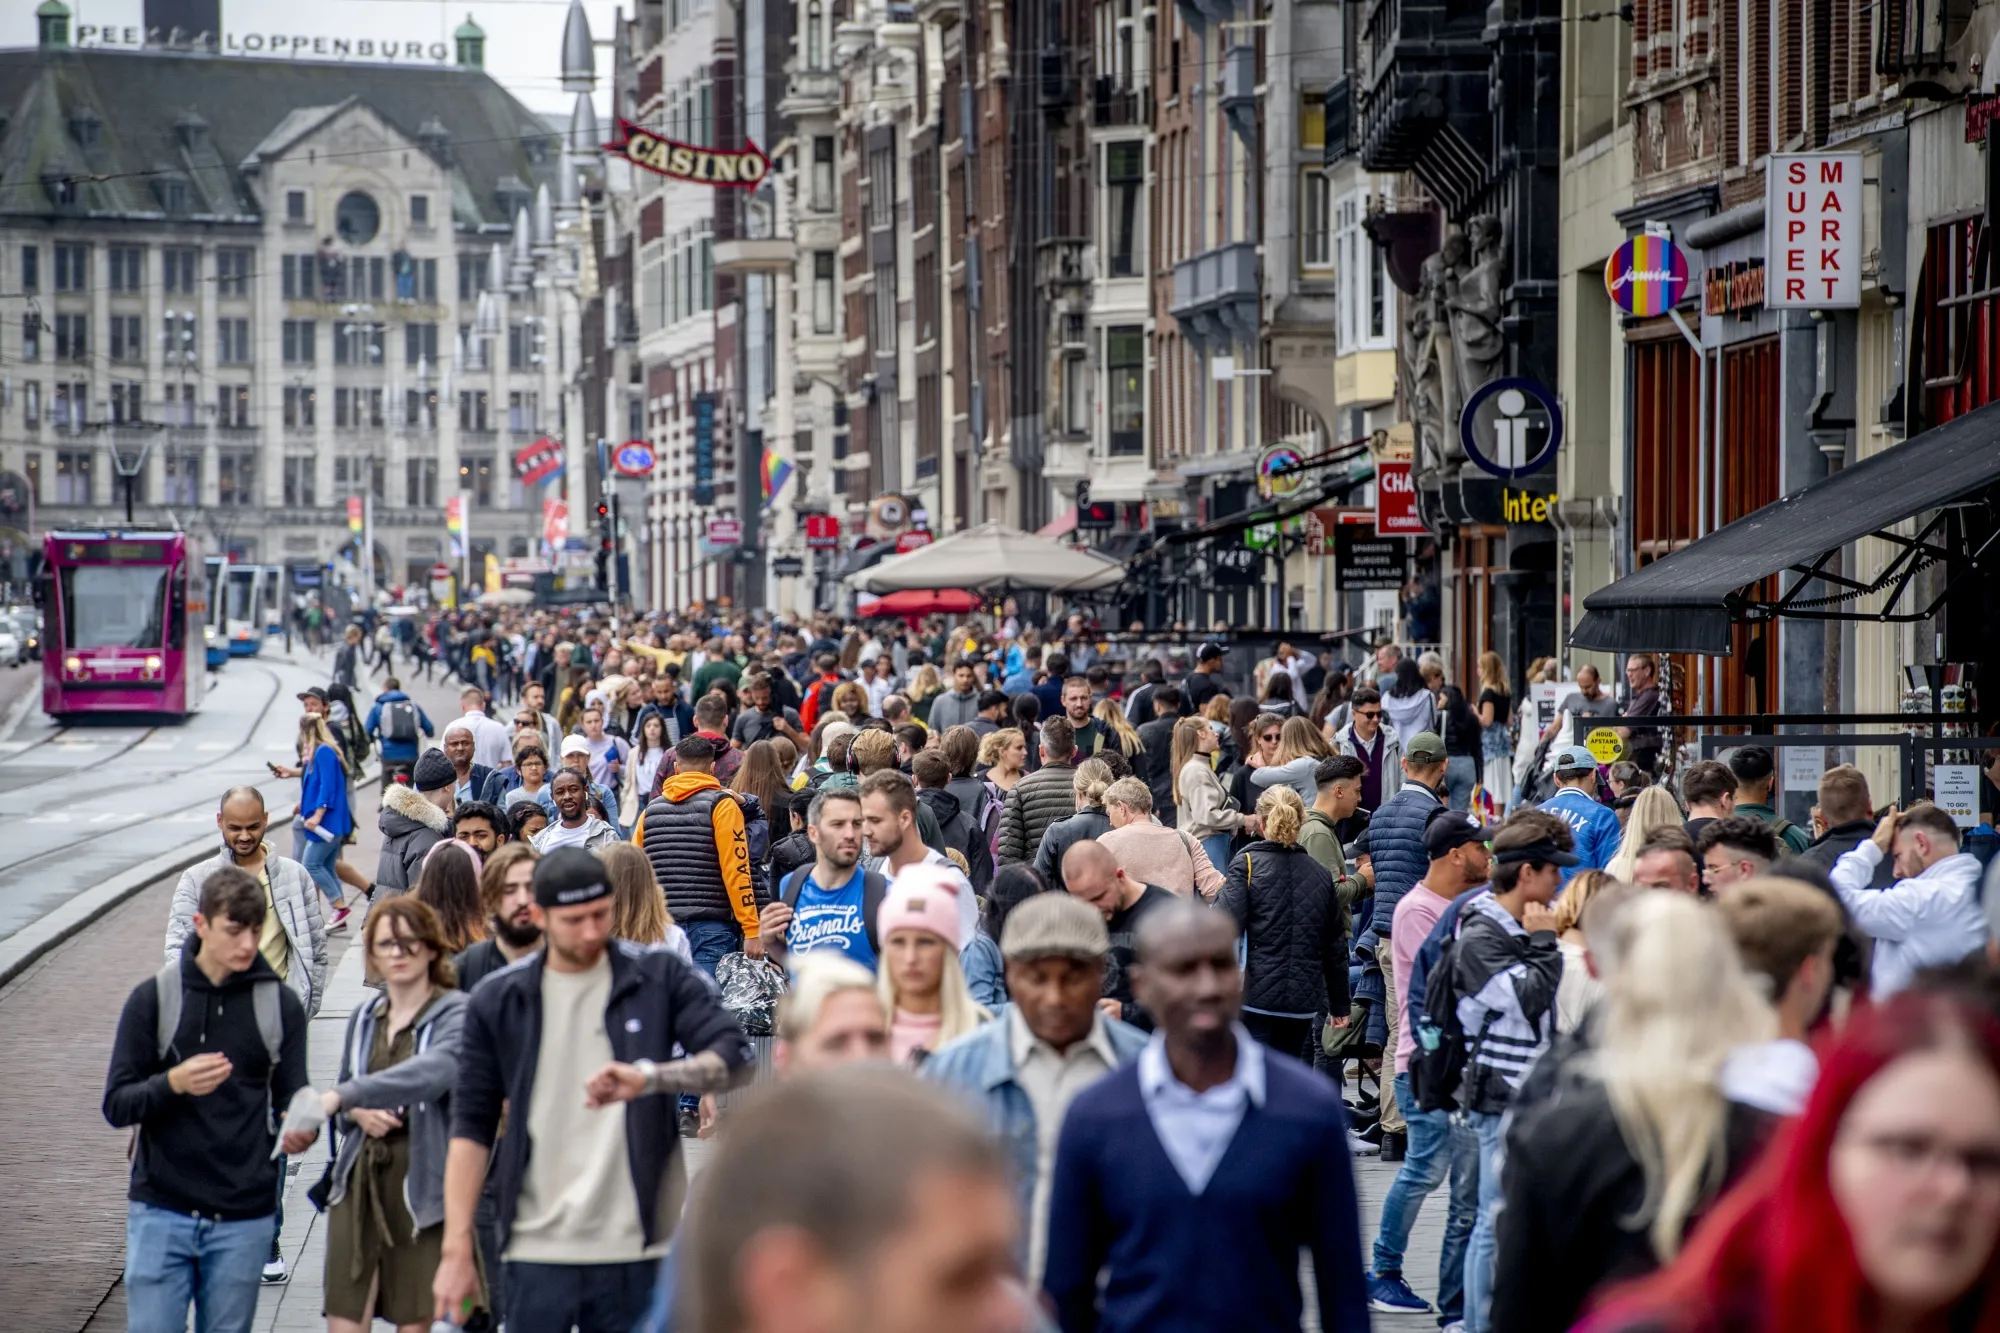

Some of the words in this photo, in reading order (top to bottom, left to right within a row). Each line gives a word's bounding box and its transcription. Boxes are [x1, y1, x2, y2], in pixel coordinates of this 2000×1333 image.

[627, 134, 765, 182] CASINO
[1786, 161, 1806, 300] SUPER
[1820, 161, 1843, 300] MARKT
[732, 829, 755, 907] BLACK
[786, 905, 864, 950] Originals
